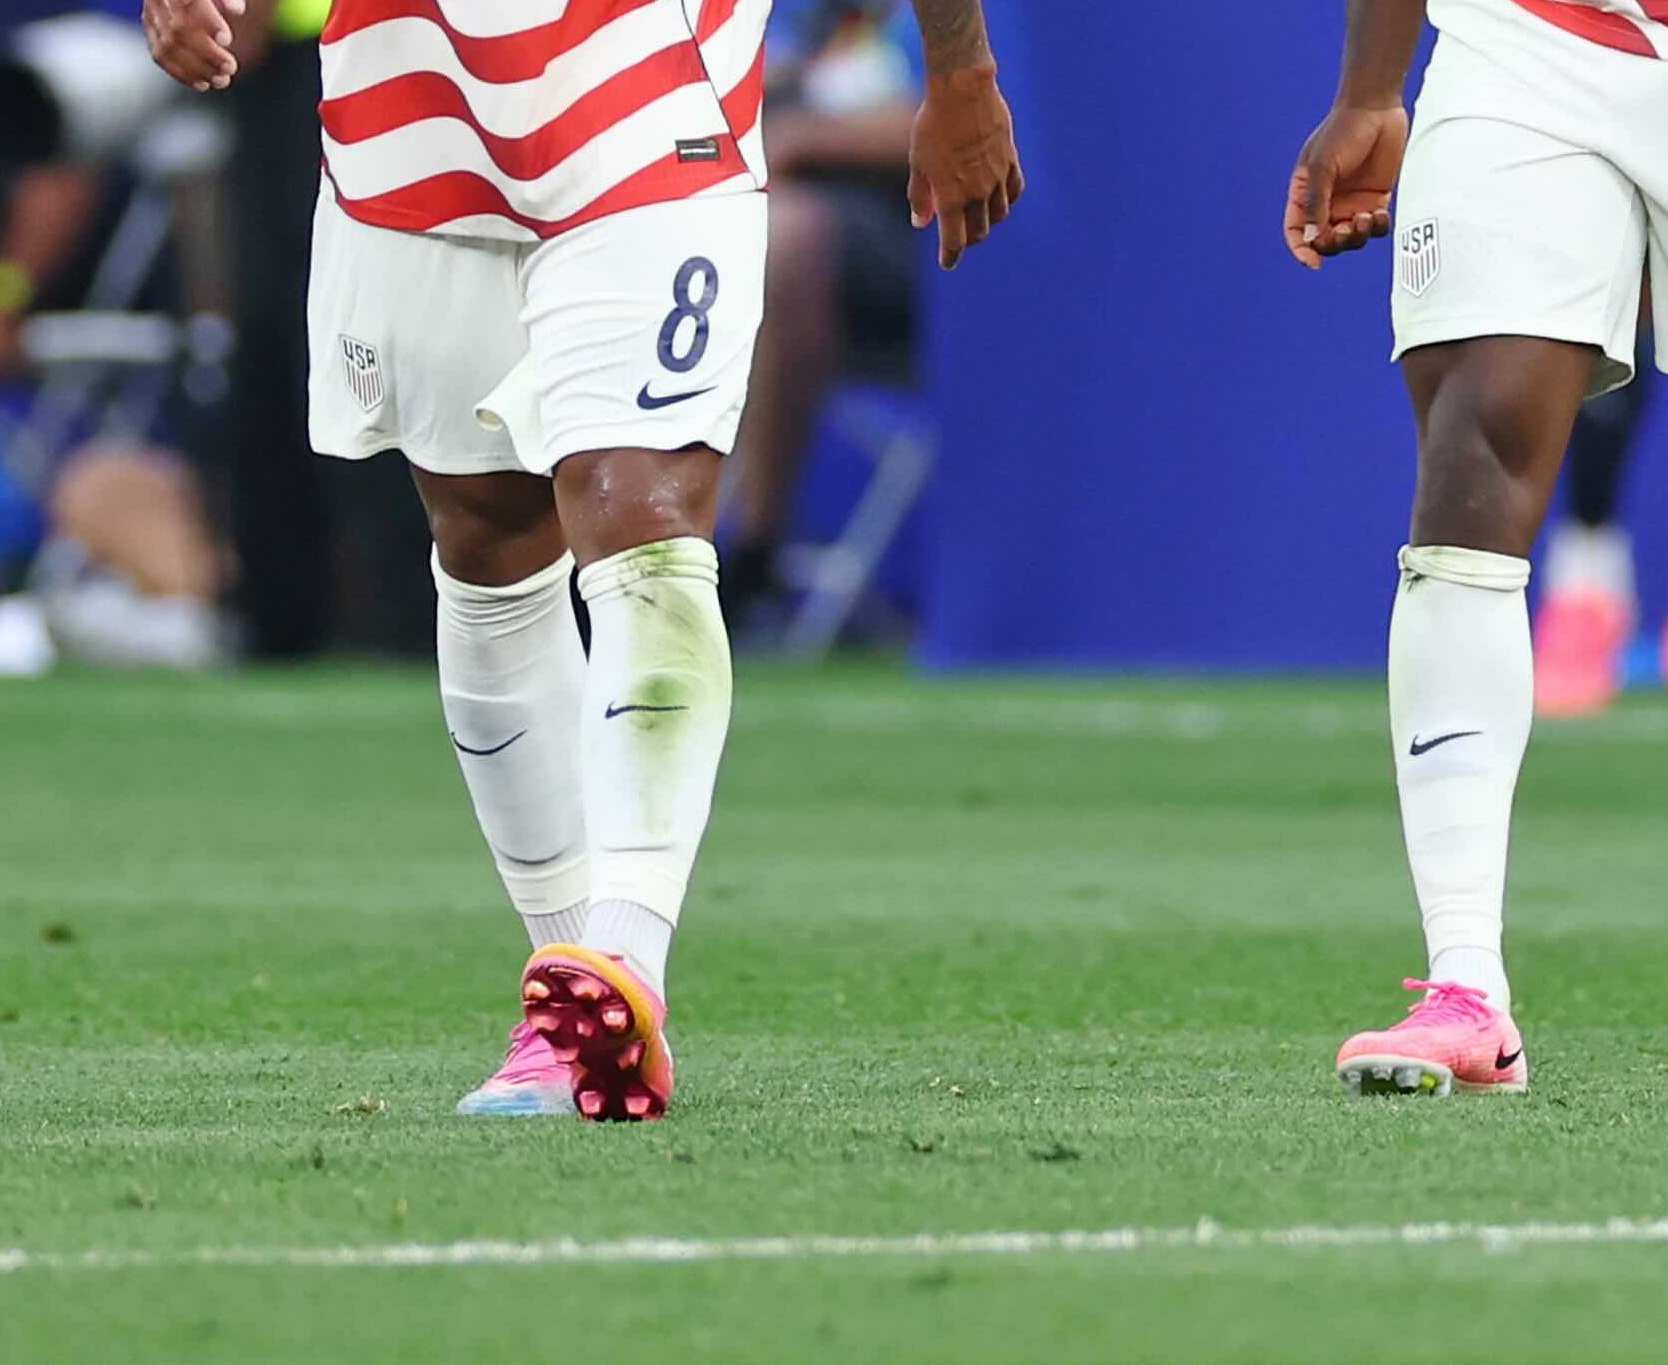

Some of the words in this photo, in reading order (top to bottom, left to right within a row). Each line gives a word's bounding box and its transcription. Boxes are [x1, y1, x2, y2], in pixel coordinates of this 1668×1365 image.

[1402, 223, 1434, 255] USA
[656, 256, 719, 373] 8
[343, 339, 375, 370] USA
